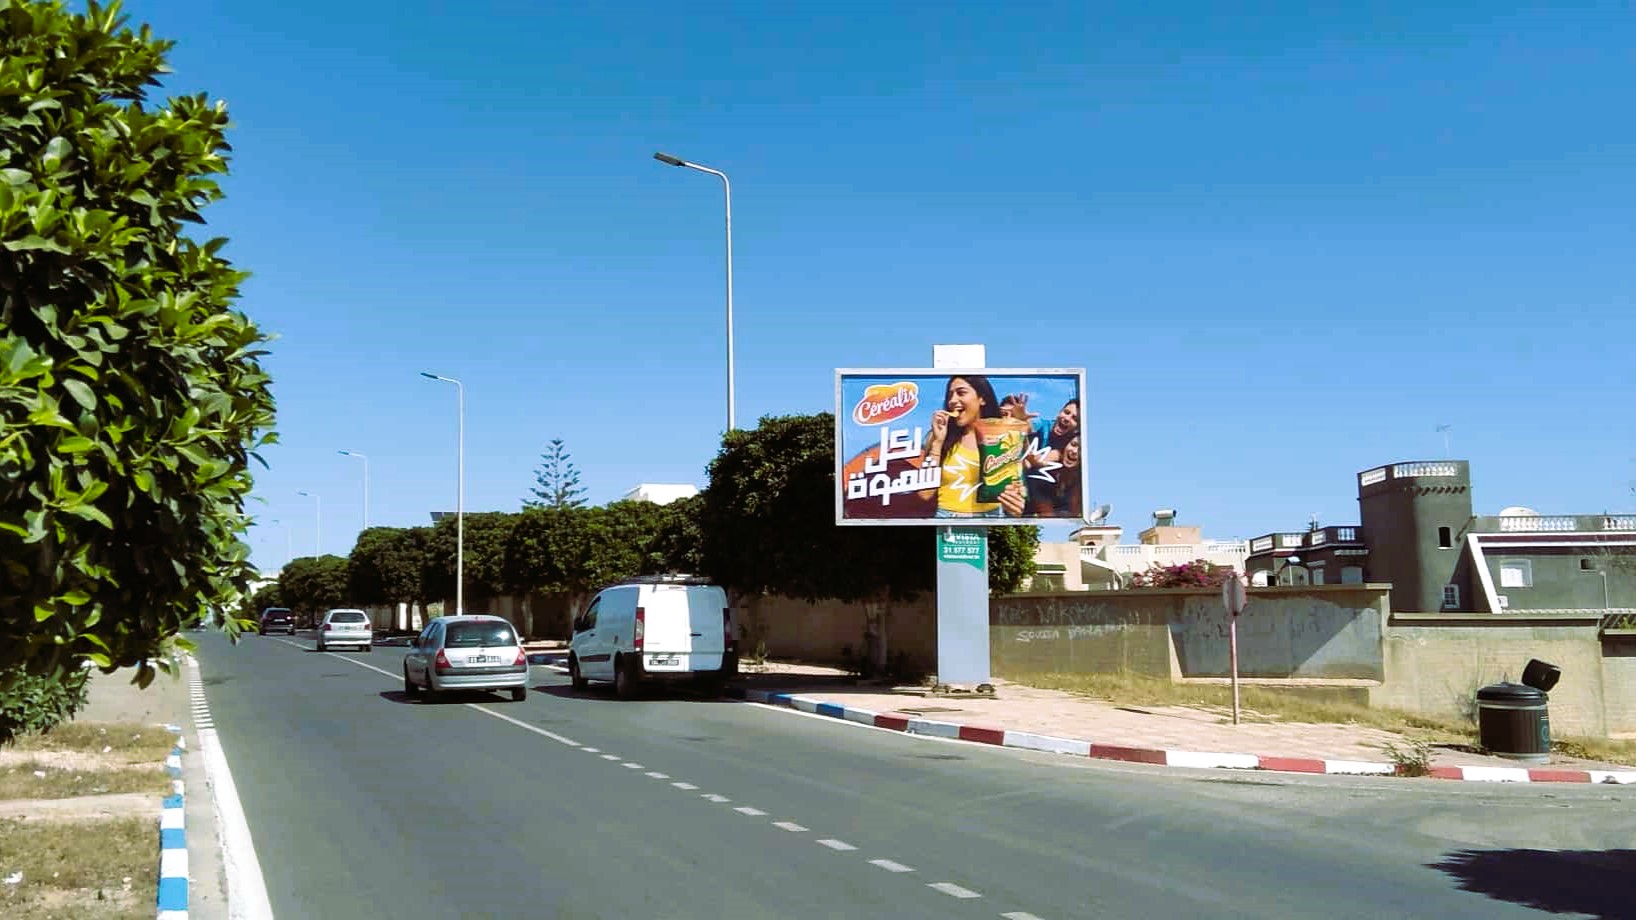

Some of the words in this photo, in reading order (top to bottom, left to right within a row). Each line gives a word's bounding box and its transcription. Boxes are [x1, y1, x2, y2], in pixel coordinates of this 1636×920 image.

[858, 386, 916, 423] Céréalis
[865, 427, 922, 473] لكل
[848, 457, 941, 505] شهوة
